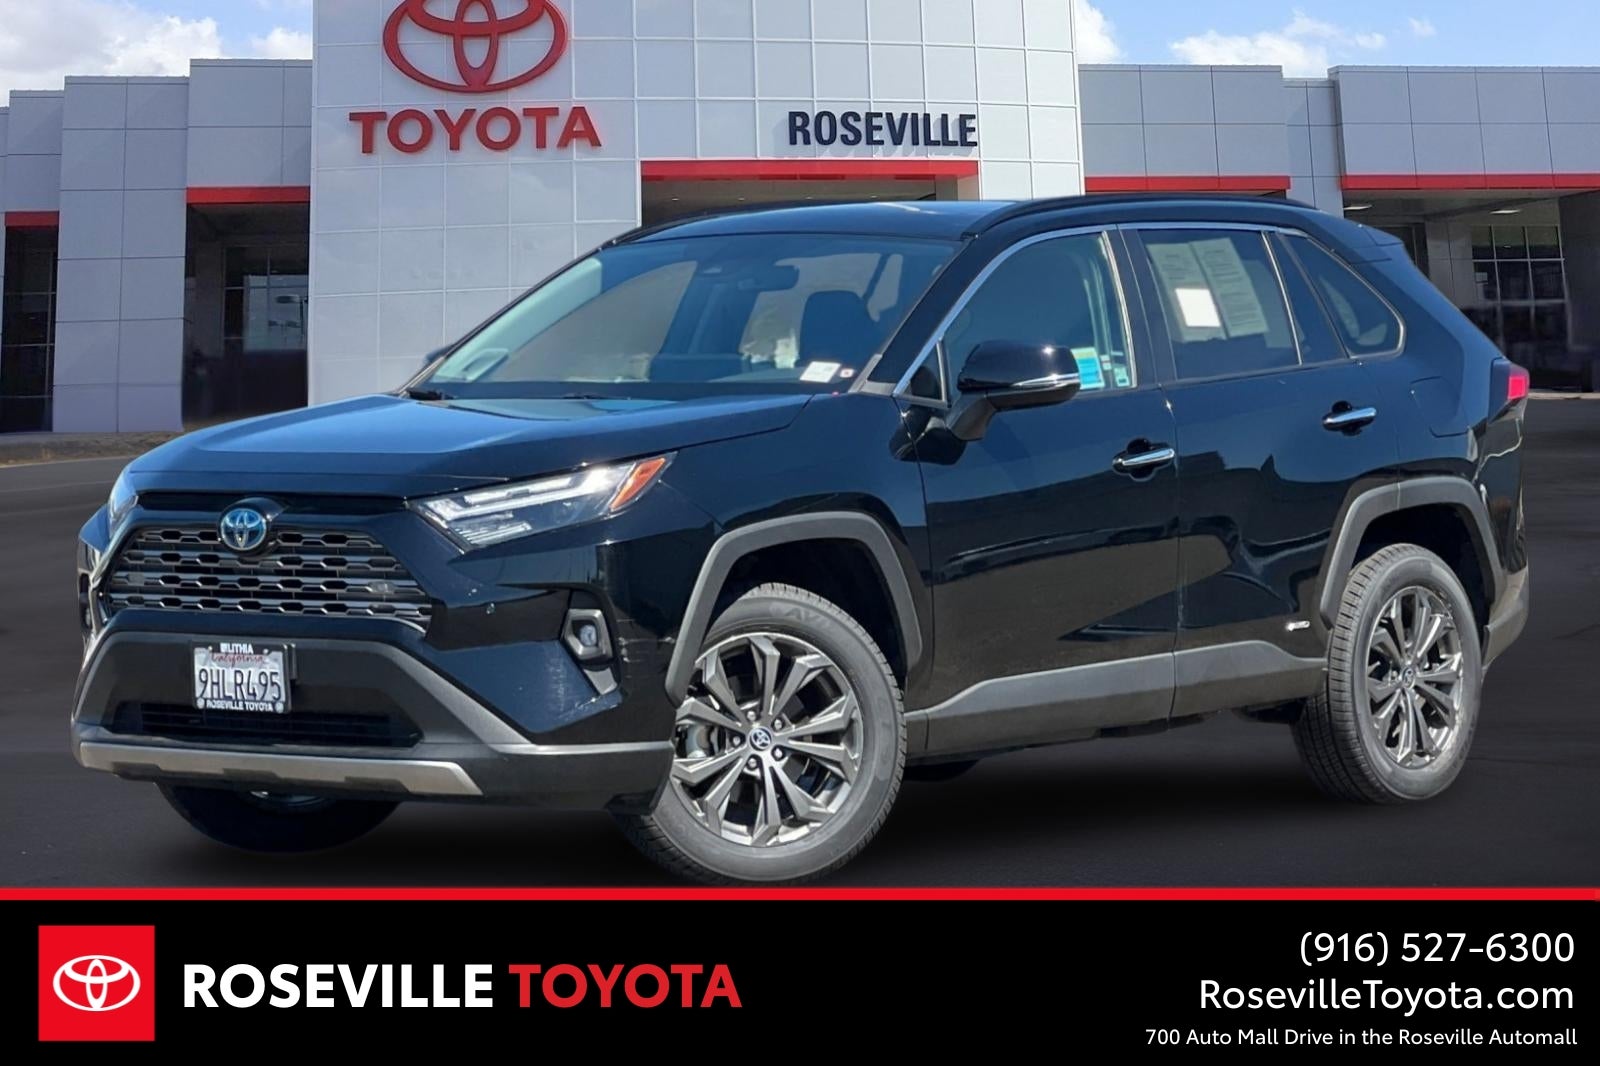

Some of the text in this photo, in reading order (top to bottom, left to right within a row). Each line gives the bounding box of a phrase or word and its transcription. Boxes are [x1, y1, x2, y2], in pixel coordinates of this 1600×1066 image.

[349, 106, 602, 154] TOYOTA
[789, 111, 978, 147] ROSEVILLE
[226, 643, 254, 654] LITHIA
[199, 668, 281, 700] 9HLR495
[206, 700, 274, 712] ROSEVILLE TOYOTA
